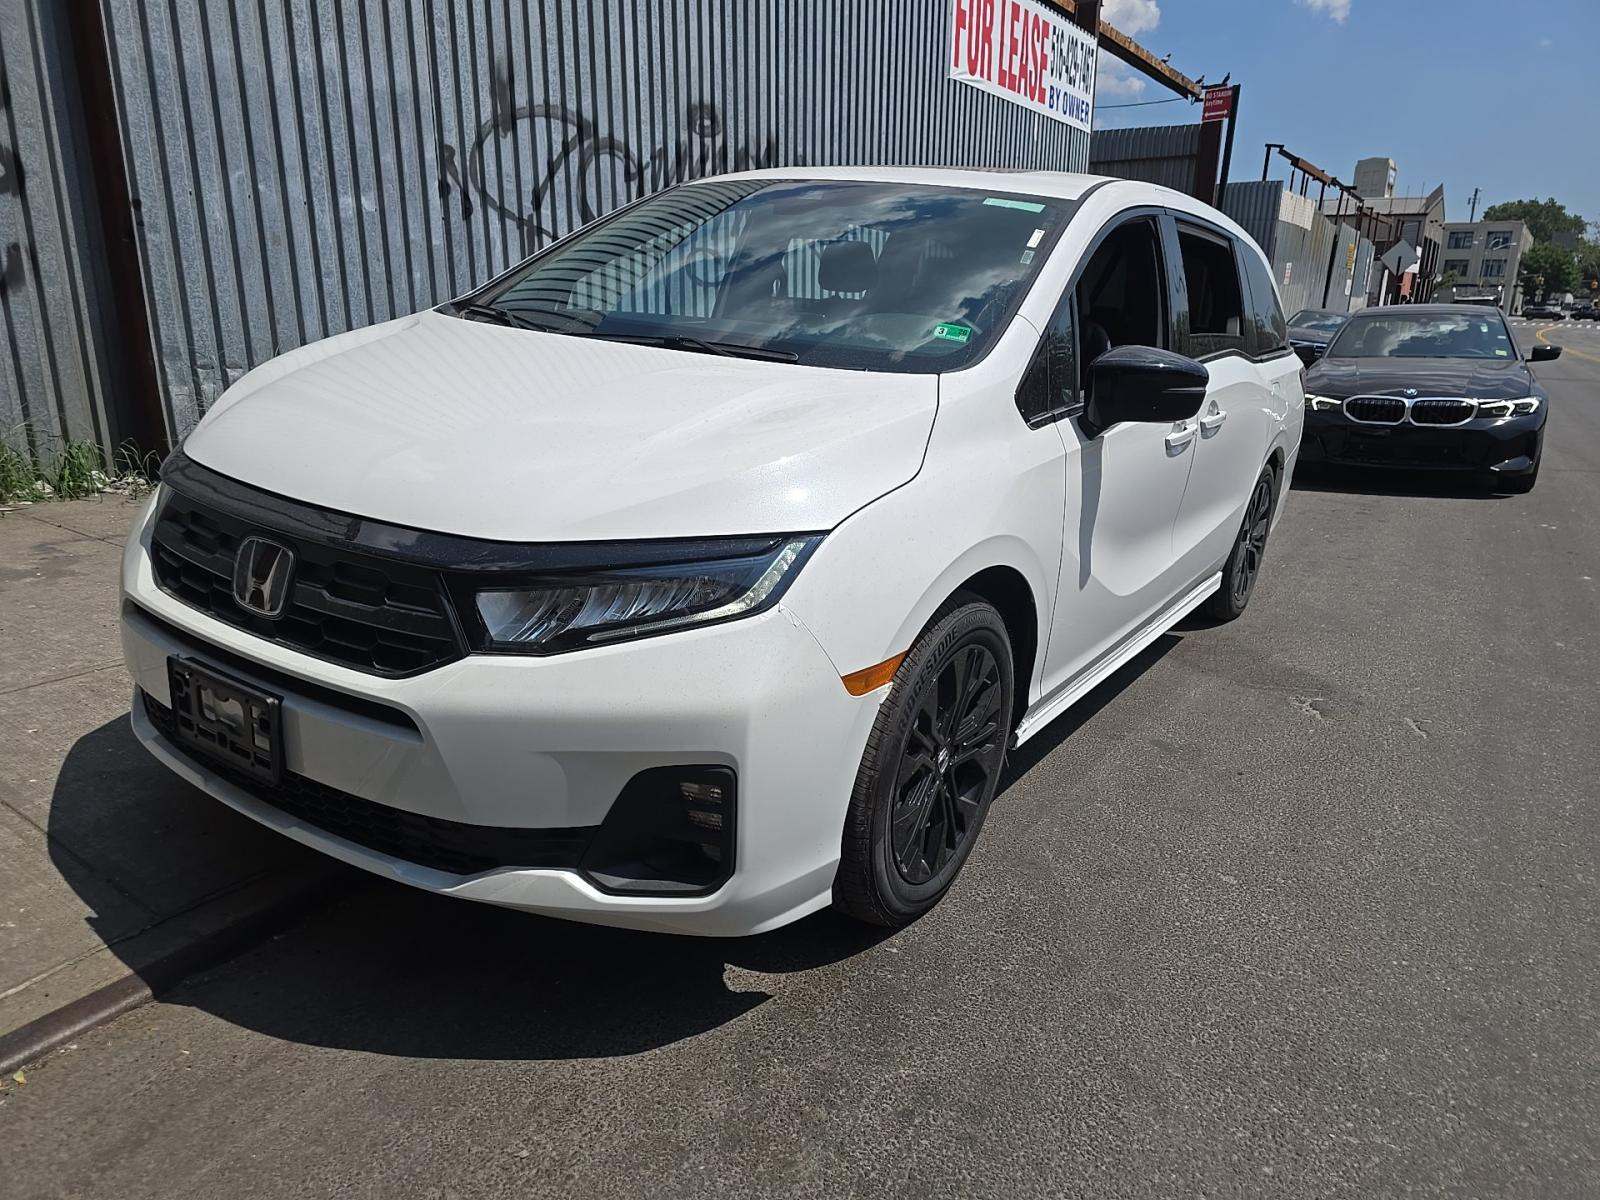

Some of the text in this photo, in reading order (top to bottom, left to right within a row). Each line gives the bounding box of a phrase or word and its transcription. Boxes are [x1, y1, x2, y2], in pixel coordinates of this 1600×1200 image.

[953, 0, 1050, 105] FOR LEASE
[1049, 85, 1090, 125] BY OWNER
